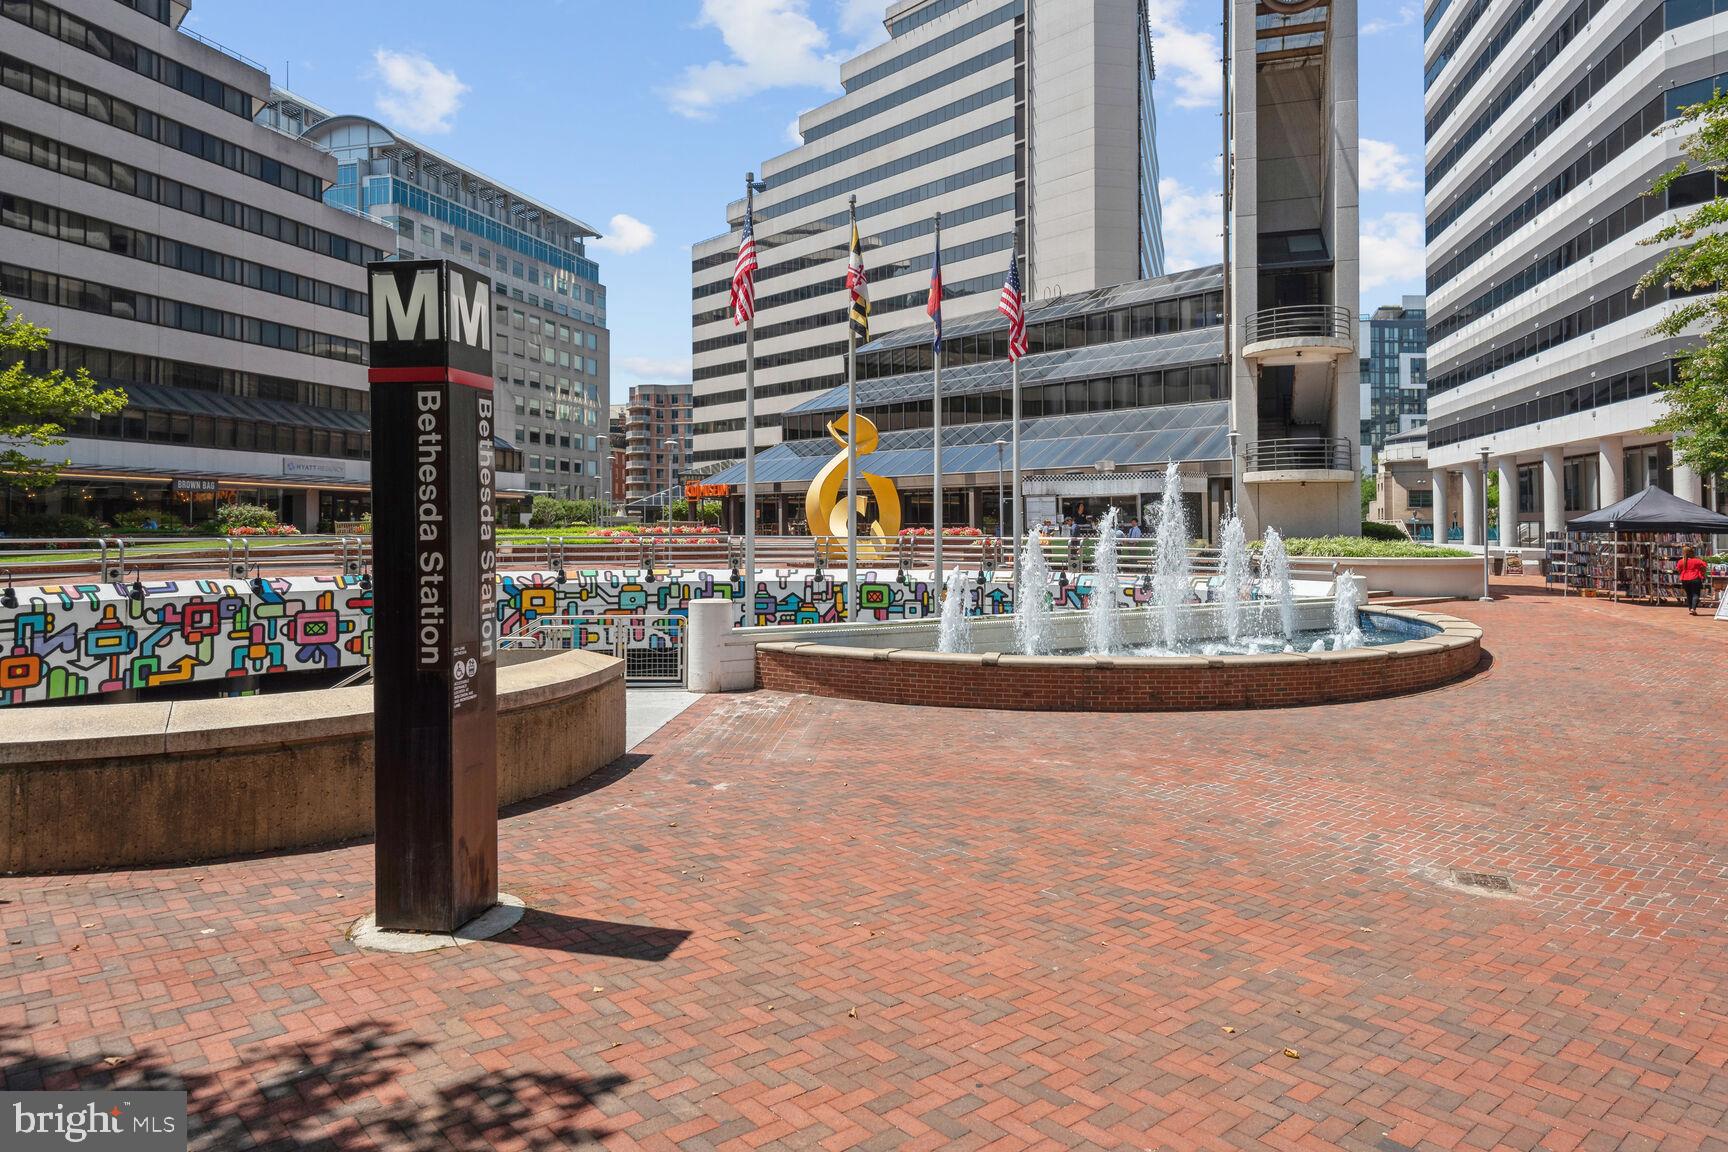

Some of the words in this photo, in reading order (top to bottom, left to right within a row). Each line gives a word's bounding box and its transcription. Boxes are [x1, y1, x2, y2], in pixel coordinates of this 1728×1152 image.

[372, 268, 440, 341] M
[450, 269, 491, 351] M
[177, 480, 201, 489] BROWN
[202, 481, 215, 490] BAG
[296, 463, 318, 471] HYATT
[417, 390, 443, 541] Bethesda
[478, 398, 494, 541] Bethesda
[419, 551, 445, 664] Station
[481, 550, 495, 657] Station
